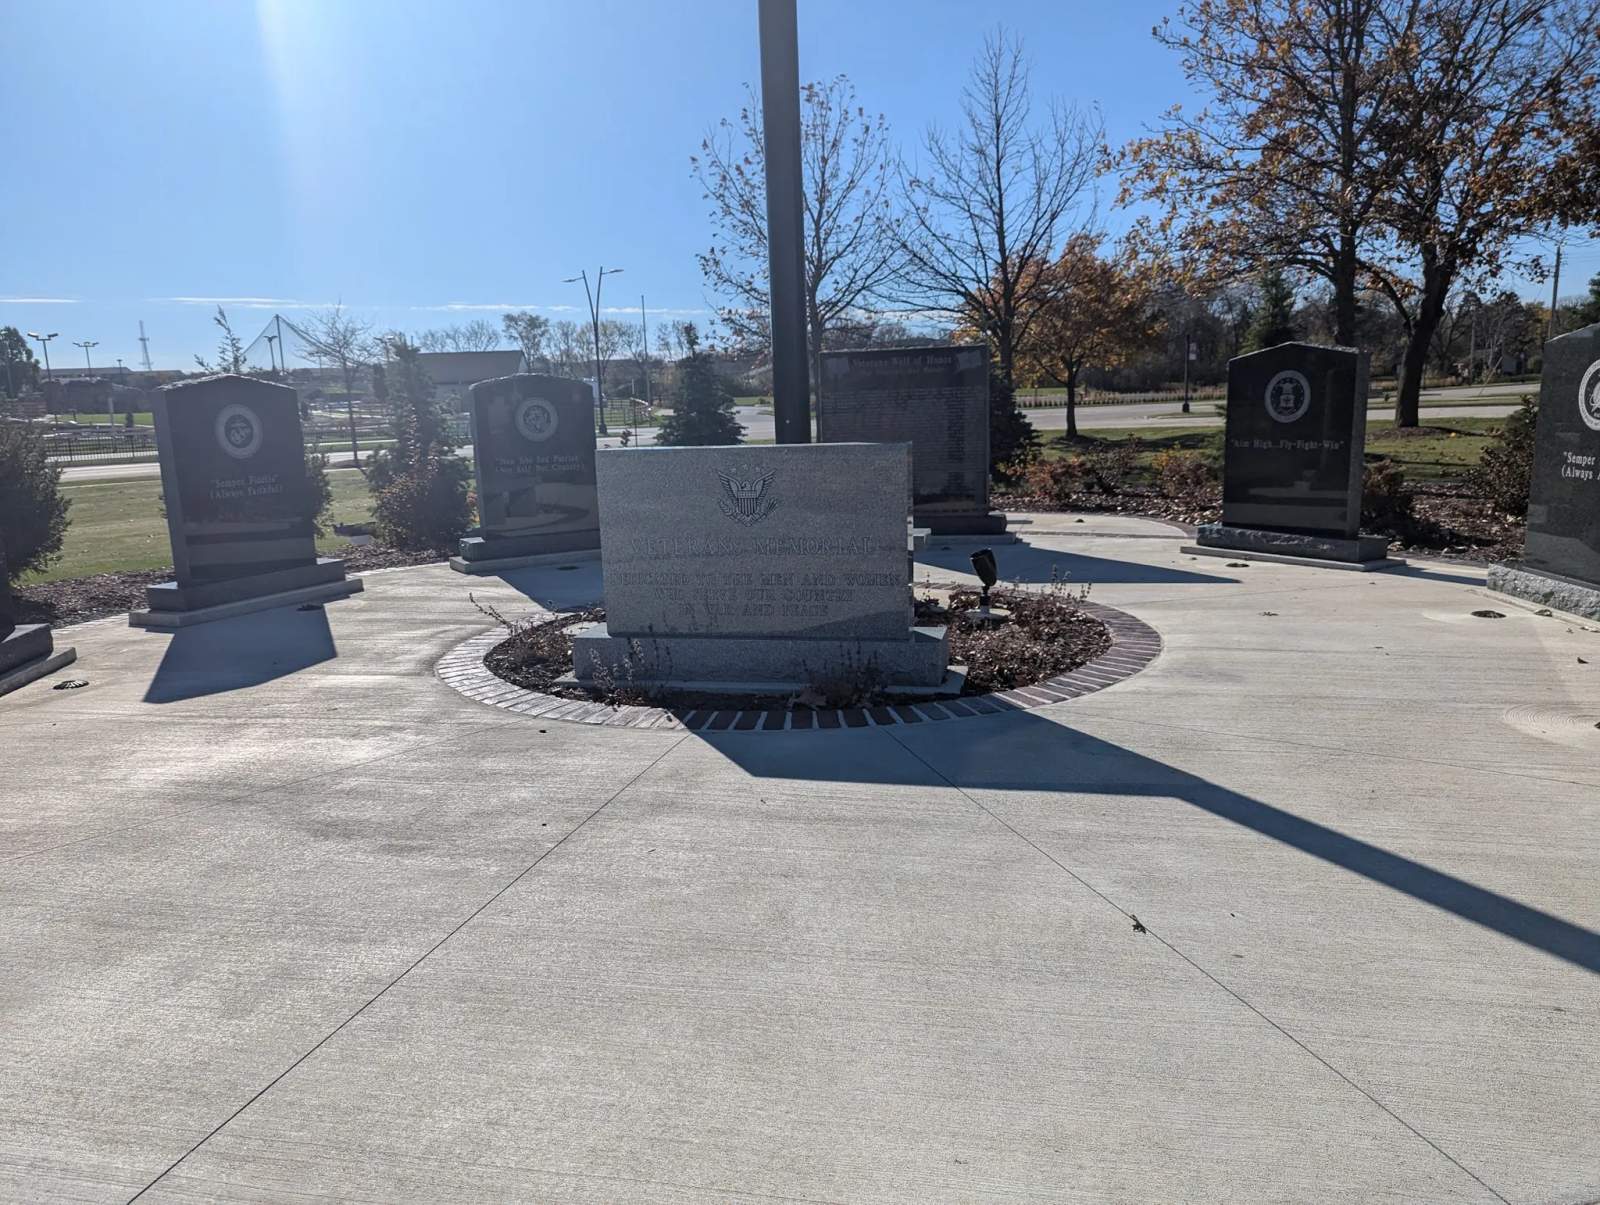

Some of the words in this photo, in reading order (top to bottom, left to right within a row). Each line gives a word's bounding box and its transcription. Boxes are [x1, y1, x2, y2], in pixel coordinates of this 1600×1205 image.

[1563, 451, 1596, 467] "Semper
[1561, 464, 1594, 481] (Always
[751, 534, 872, 556] MEMORIAL
